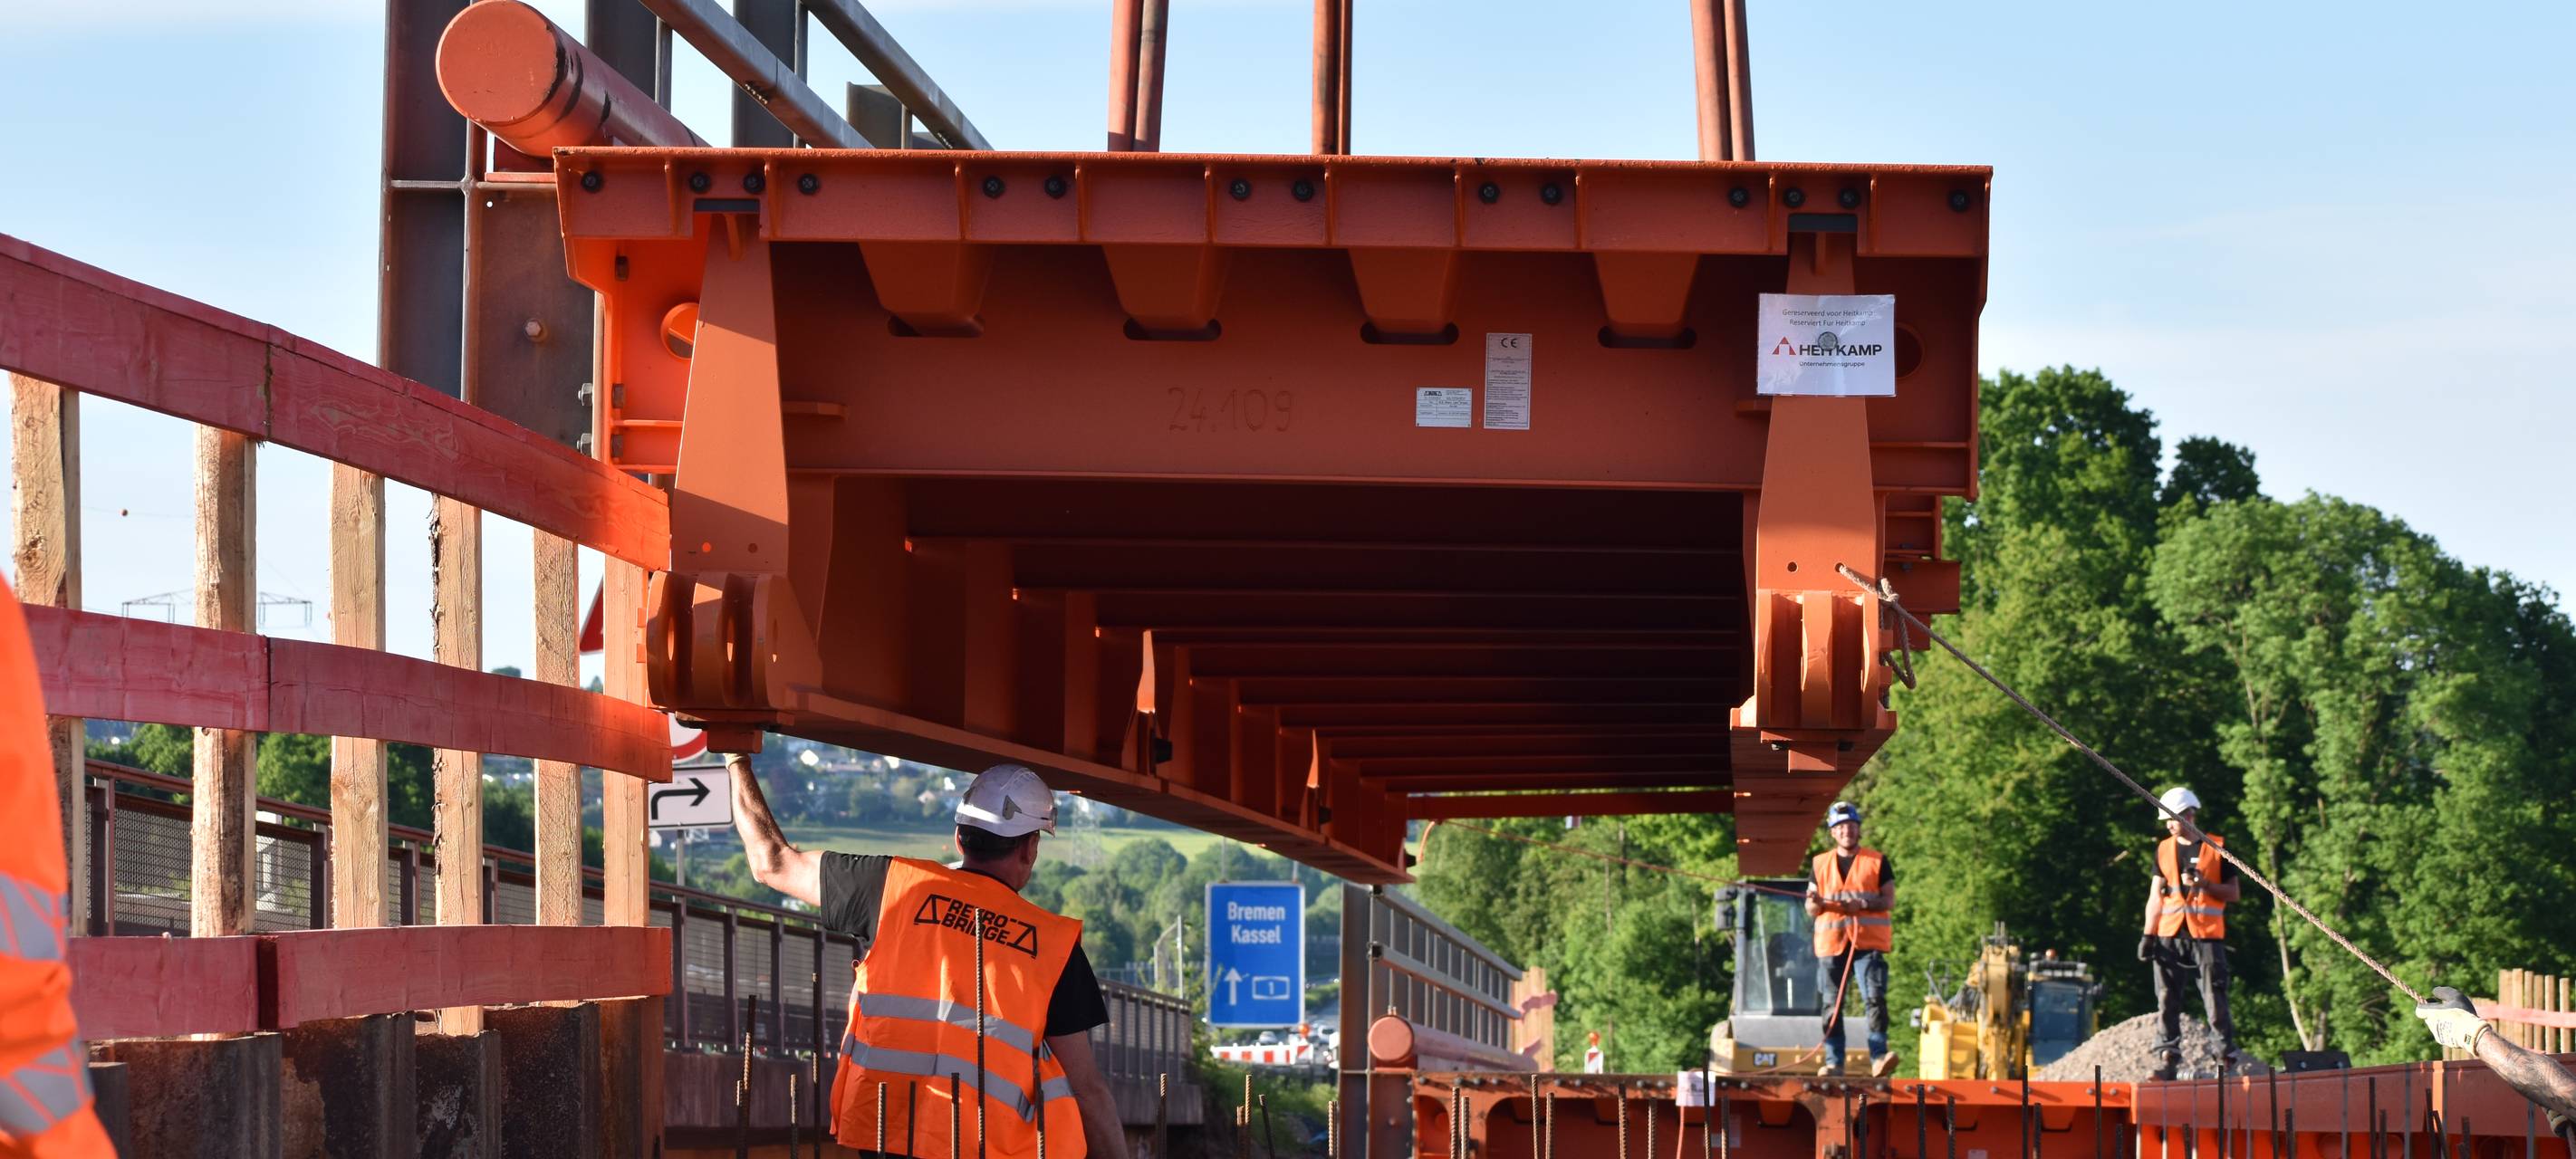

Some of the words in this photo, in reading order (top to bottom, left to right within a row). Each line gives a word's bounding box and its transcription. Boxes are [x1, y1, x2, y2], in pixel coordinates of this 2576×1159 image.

[1783, 309, 1825, 317] Gereserveerd
[1227, 901, 1285, 921] Bremen
[1232, 924, 1282, 943] Kassel
[1754, 1052, 1776, 1066] CAT
